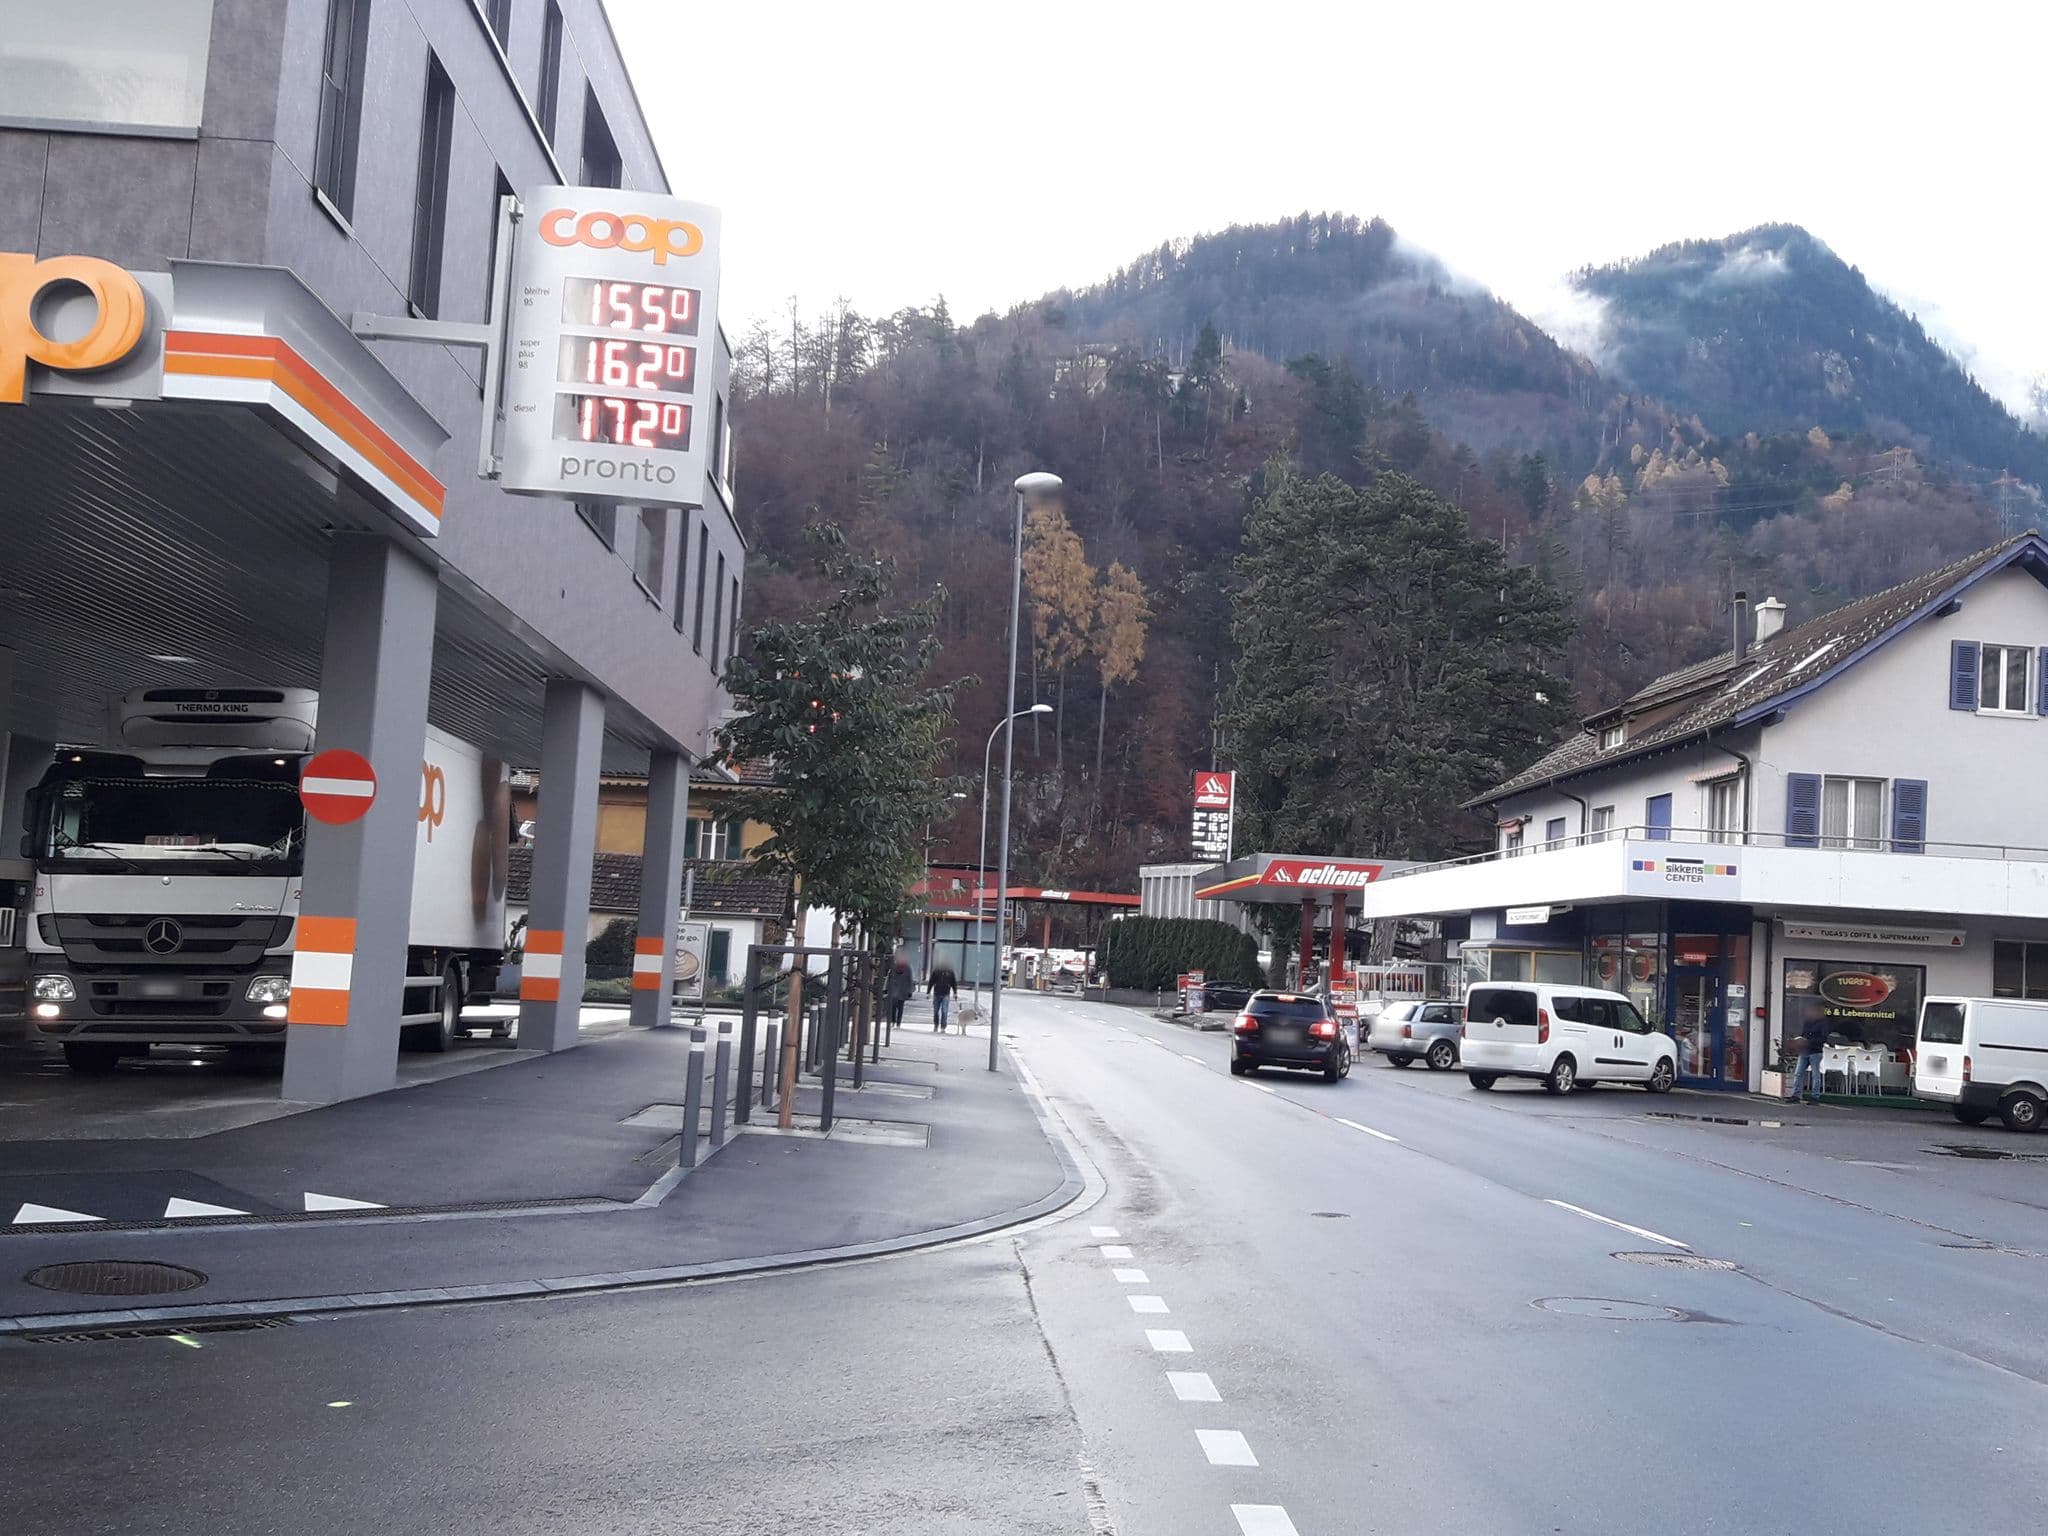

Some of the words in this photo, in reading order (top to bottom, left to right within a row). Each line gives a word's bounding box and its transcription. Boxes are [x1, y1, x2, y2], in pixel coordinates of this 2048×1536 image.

[539, 208, 704, 265] coop
[519, 339, 541, 349] super
[518, 351, 535, 360] plus
[514, 403, 537, 413] diesel
[560, 456, 677, 485] pronto
[176, 703, 221, 713] THERMO
[223, 704, 249, 713] KING
[1665, 864, 1704, 875] sikkens
[1665, 873, 1704, 883] CENTER
[1880, 933, 1930, 941] SUPERMARKET
[1842, 1009, 1896, 1019] Lebensmittel
